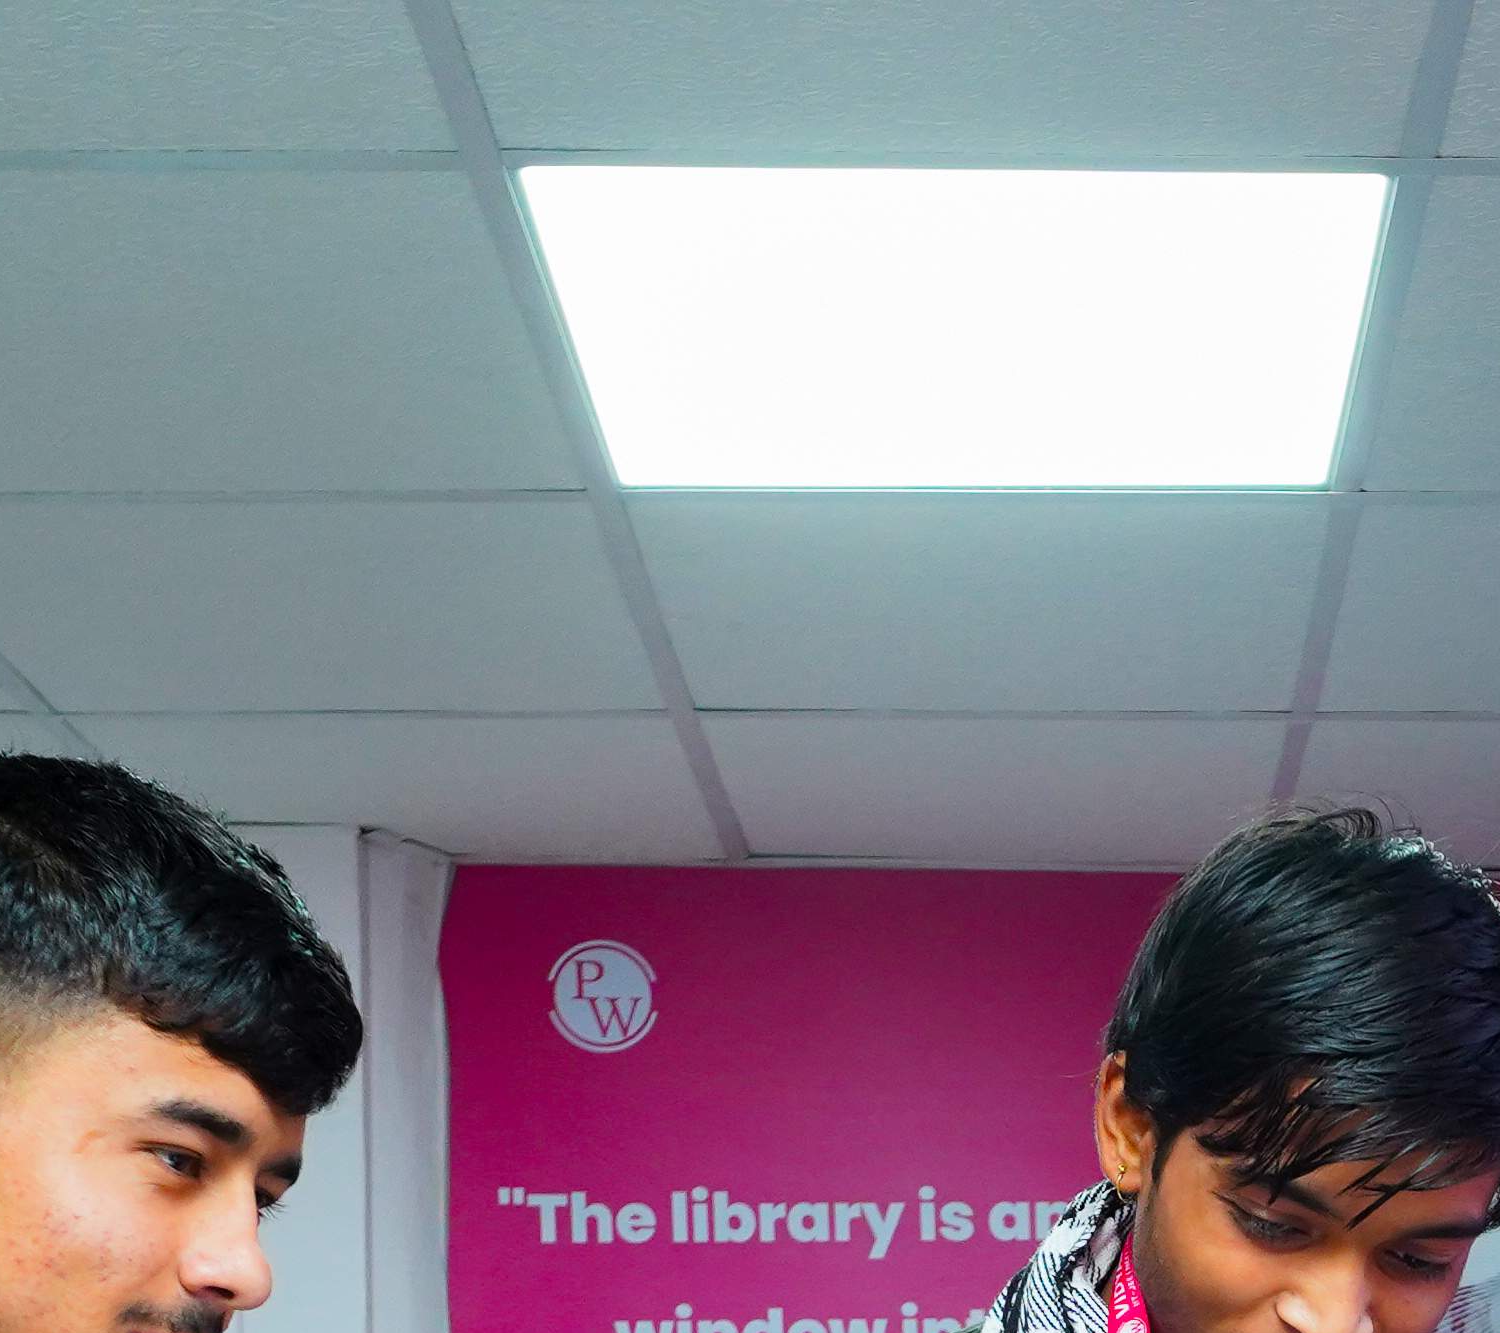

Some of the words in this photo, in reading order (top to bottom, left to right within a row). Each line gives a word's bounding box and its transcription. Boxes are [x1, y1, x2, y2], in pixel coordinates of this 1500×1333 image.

[572, 959, 642, 1038] PW
[670, 1185, 904, 1259] library
[918, 1185, 975, 1241] is
